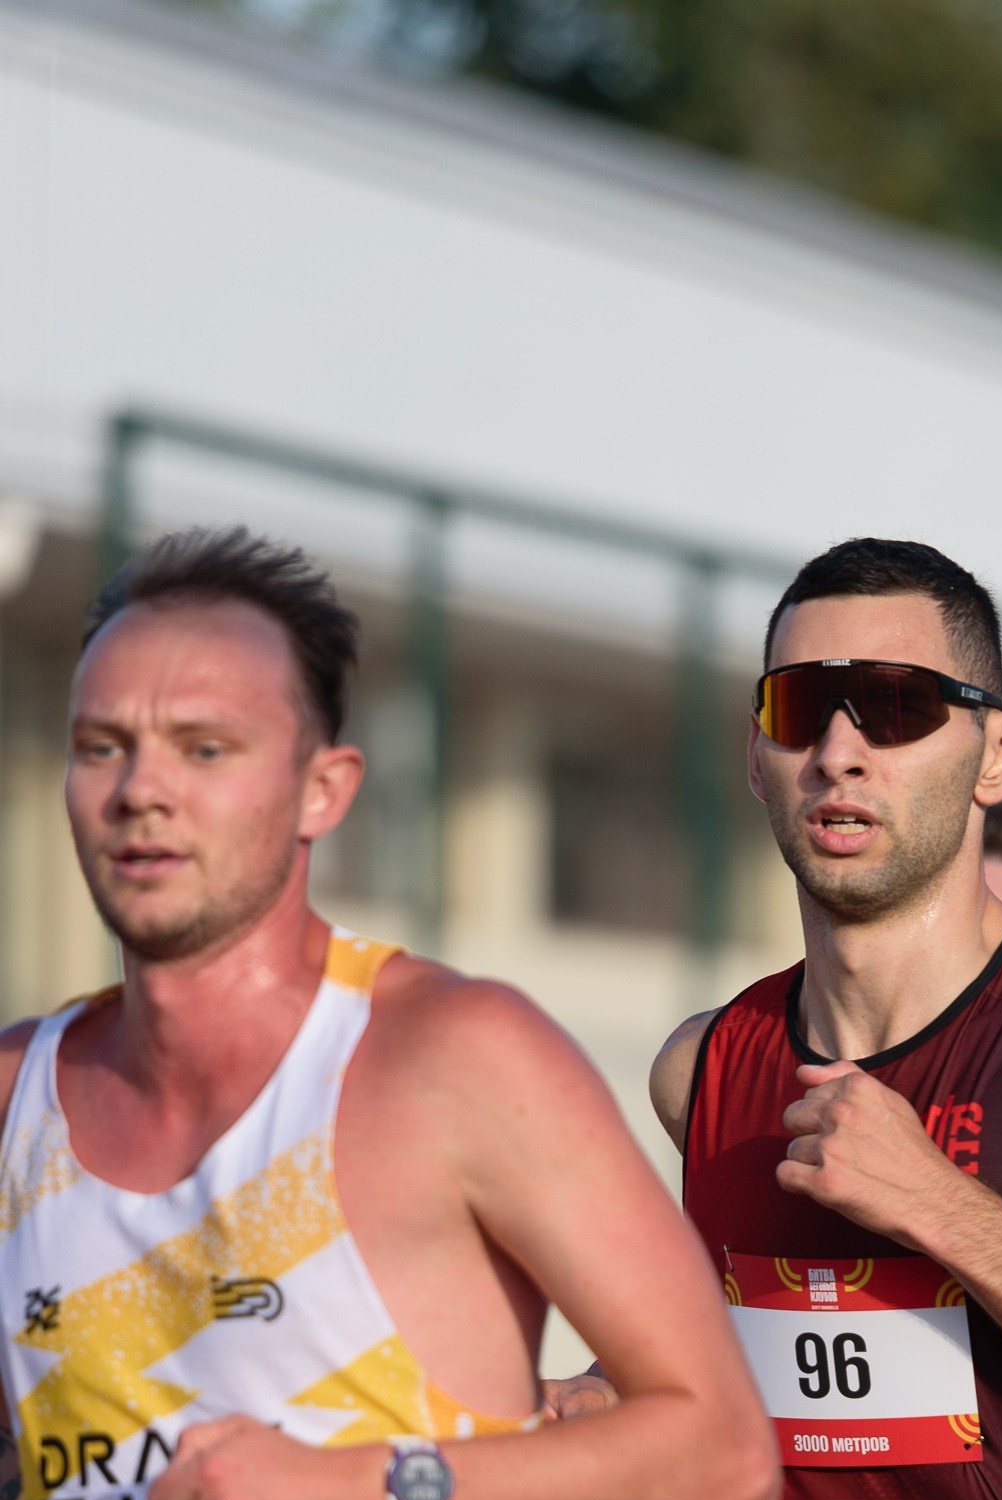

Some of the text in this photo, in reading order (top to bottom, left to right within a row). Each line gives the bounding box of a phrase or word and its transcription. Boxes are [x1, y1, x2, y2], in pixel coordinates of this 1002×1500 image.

[794, 1331, 872, 1399] 96
[39, 1427, 174, 1490] DRA
[793, 1433, 890, 1455] 3000 метров
